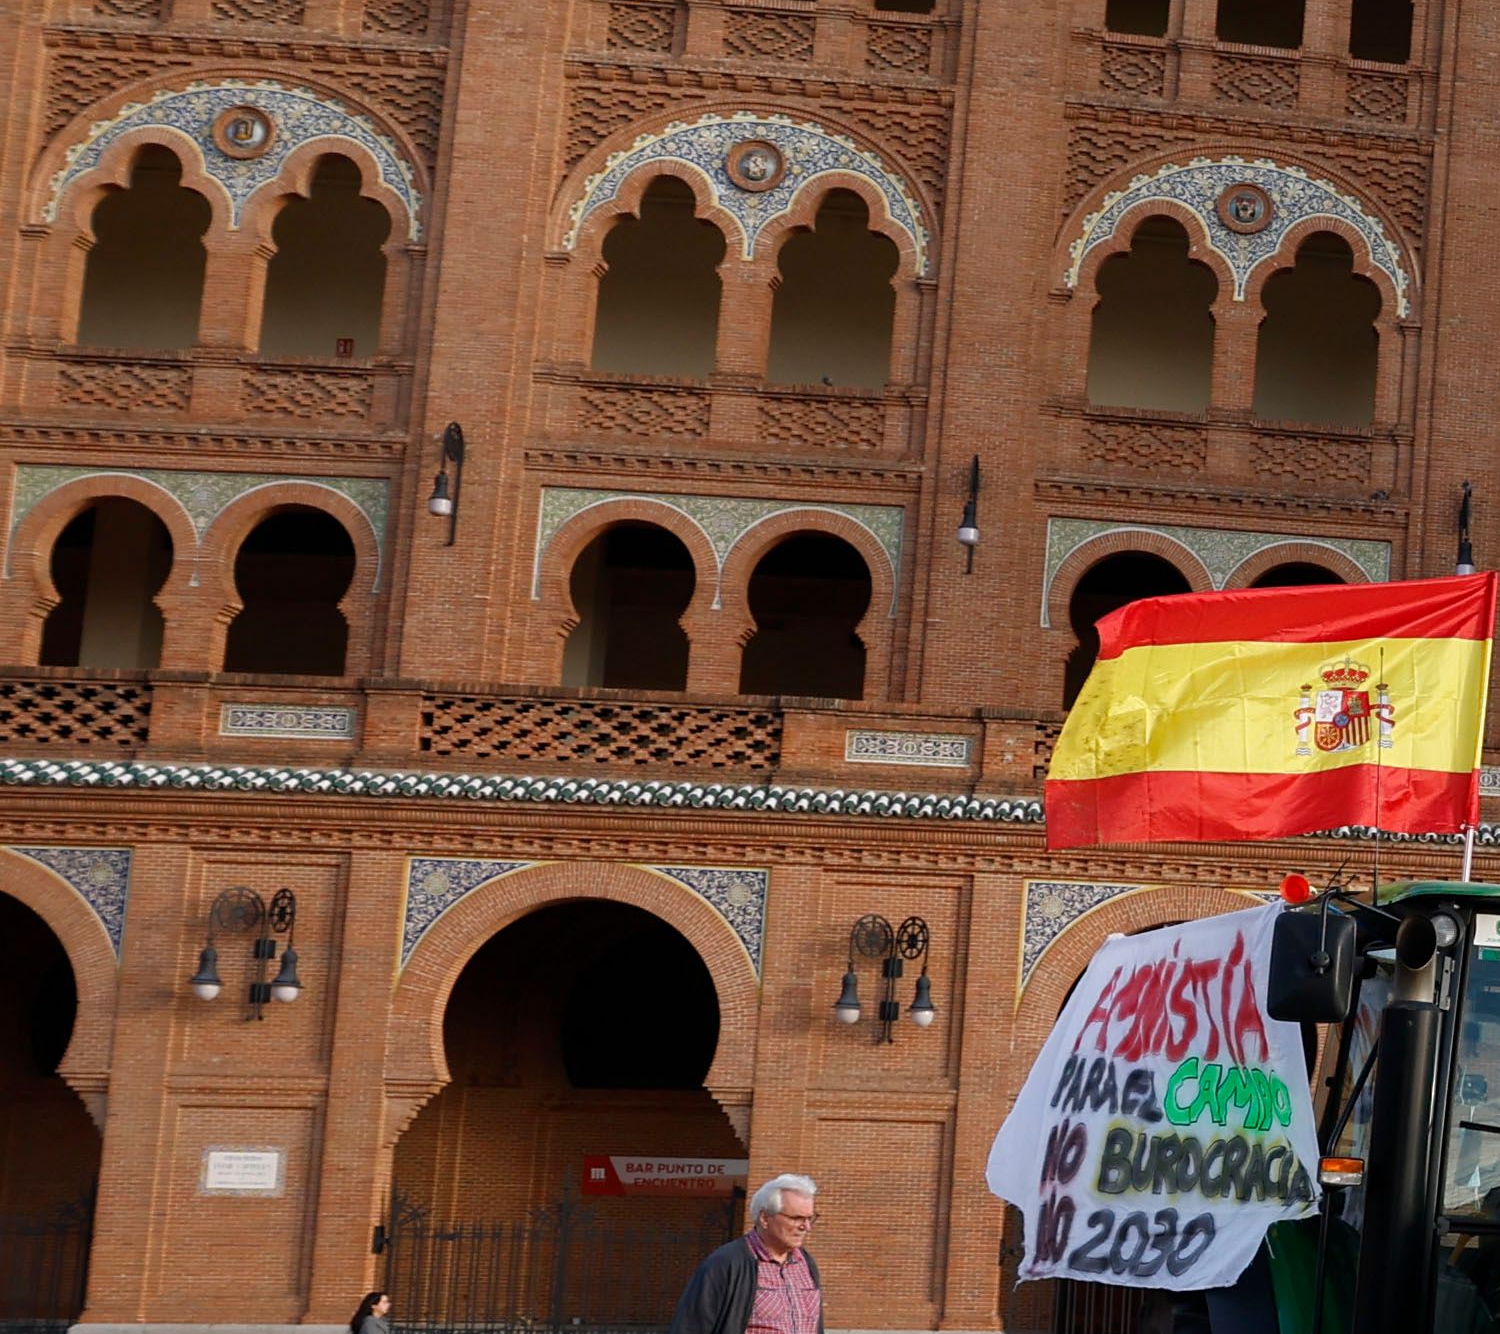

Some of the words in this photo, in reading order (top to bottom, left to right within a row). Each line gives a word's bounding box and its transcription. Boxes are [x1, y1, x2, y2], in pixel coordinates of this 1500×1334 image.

[1051, 1053, 1119, 1113] PARA
[1121, 1069, 1163, 1122] EL
[1163, 1057, 1293, 1131] CAMPO
[626, 1162, 652, 1173] BAR
[657, 1163, 703, 1175] PUNTO
[707, 1164, 726, 1175] DE
[634, 1177, 715, 1188] ENCUENTRO
[1041, 1119, 1088, 1191] NO
[1098, 1126, 1314, 1205] BUROCRACIA
[1034, 1194, 1078, 1267] NO
[1068, 1207, 1217, 1276] 2030
